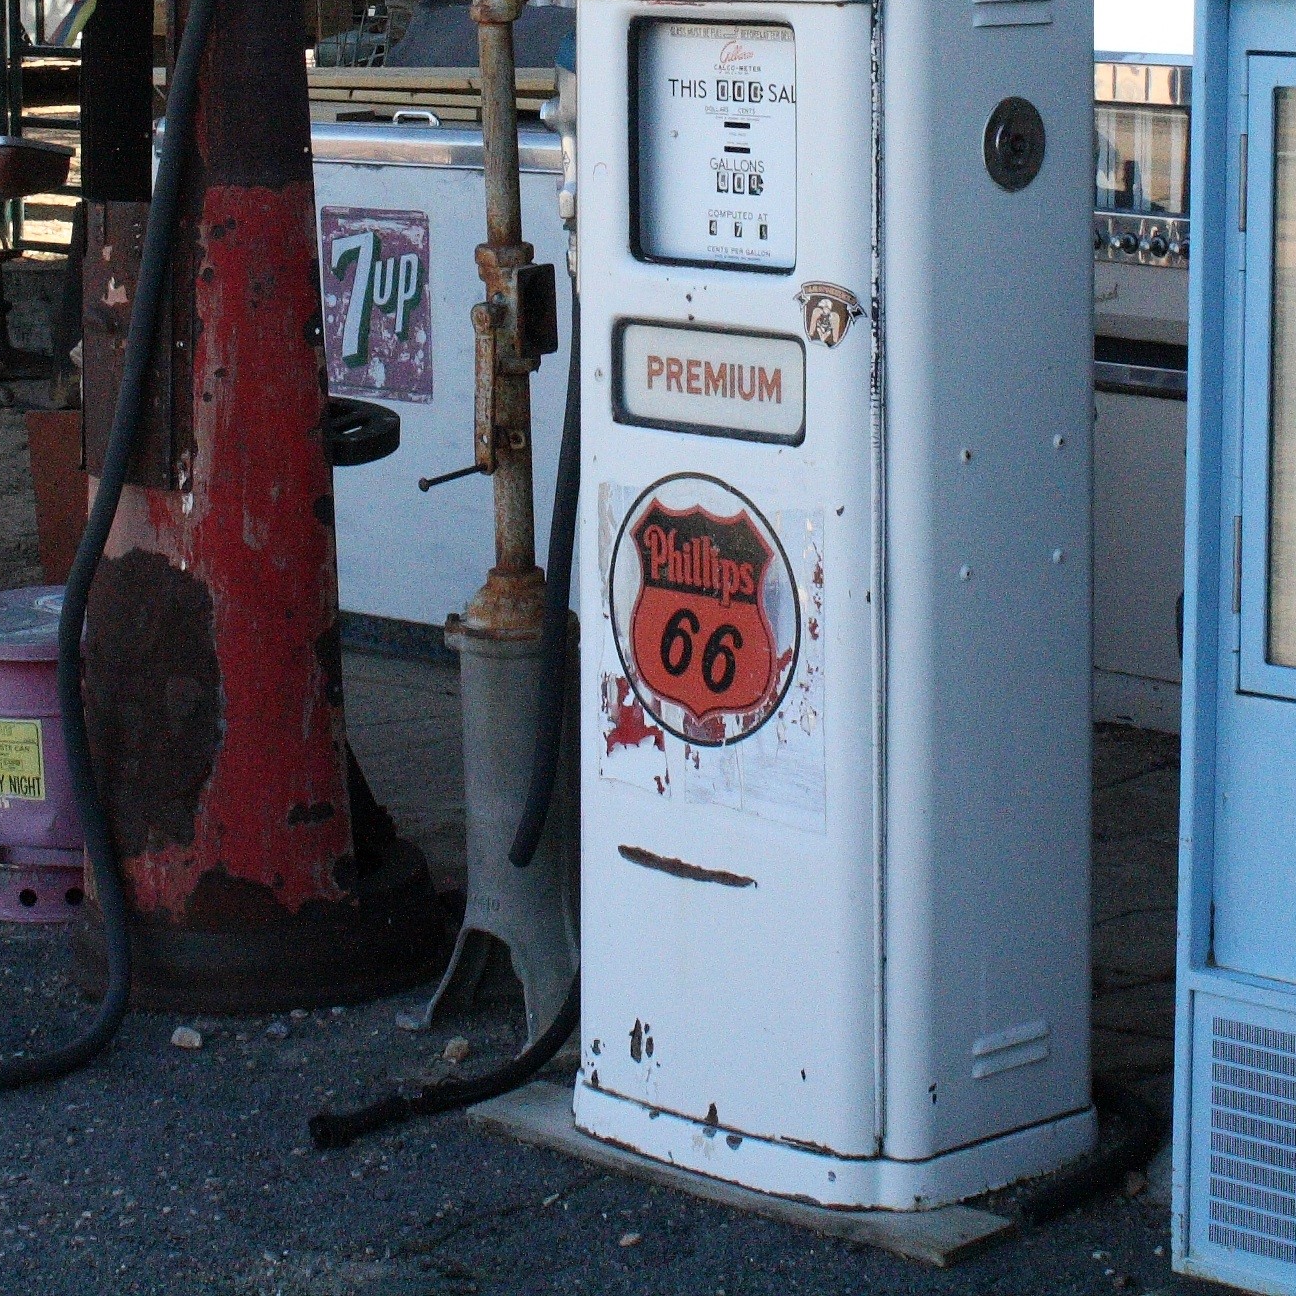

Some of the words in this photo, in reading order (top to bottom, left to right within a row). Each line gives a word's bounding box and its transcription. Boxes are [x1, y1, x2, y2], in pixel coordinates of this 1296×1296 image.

[668, 78, 707, 98] THIS
[709, 157, 765, 174] GALLONS
[707, 208, 754, 221] COMPUTED
[757, 212, 769, 222] AT
[647, 355, 783, 405] PREMIUM
[642, 523, 755, 608] Phillips
[659, 607, 745, 694] 66
[8, 774, 41, 796] NIGHT
